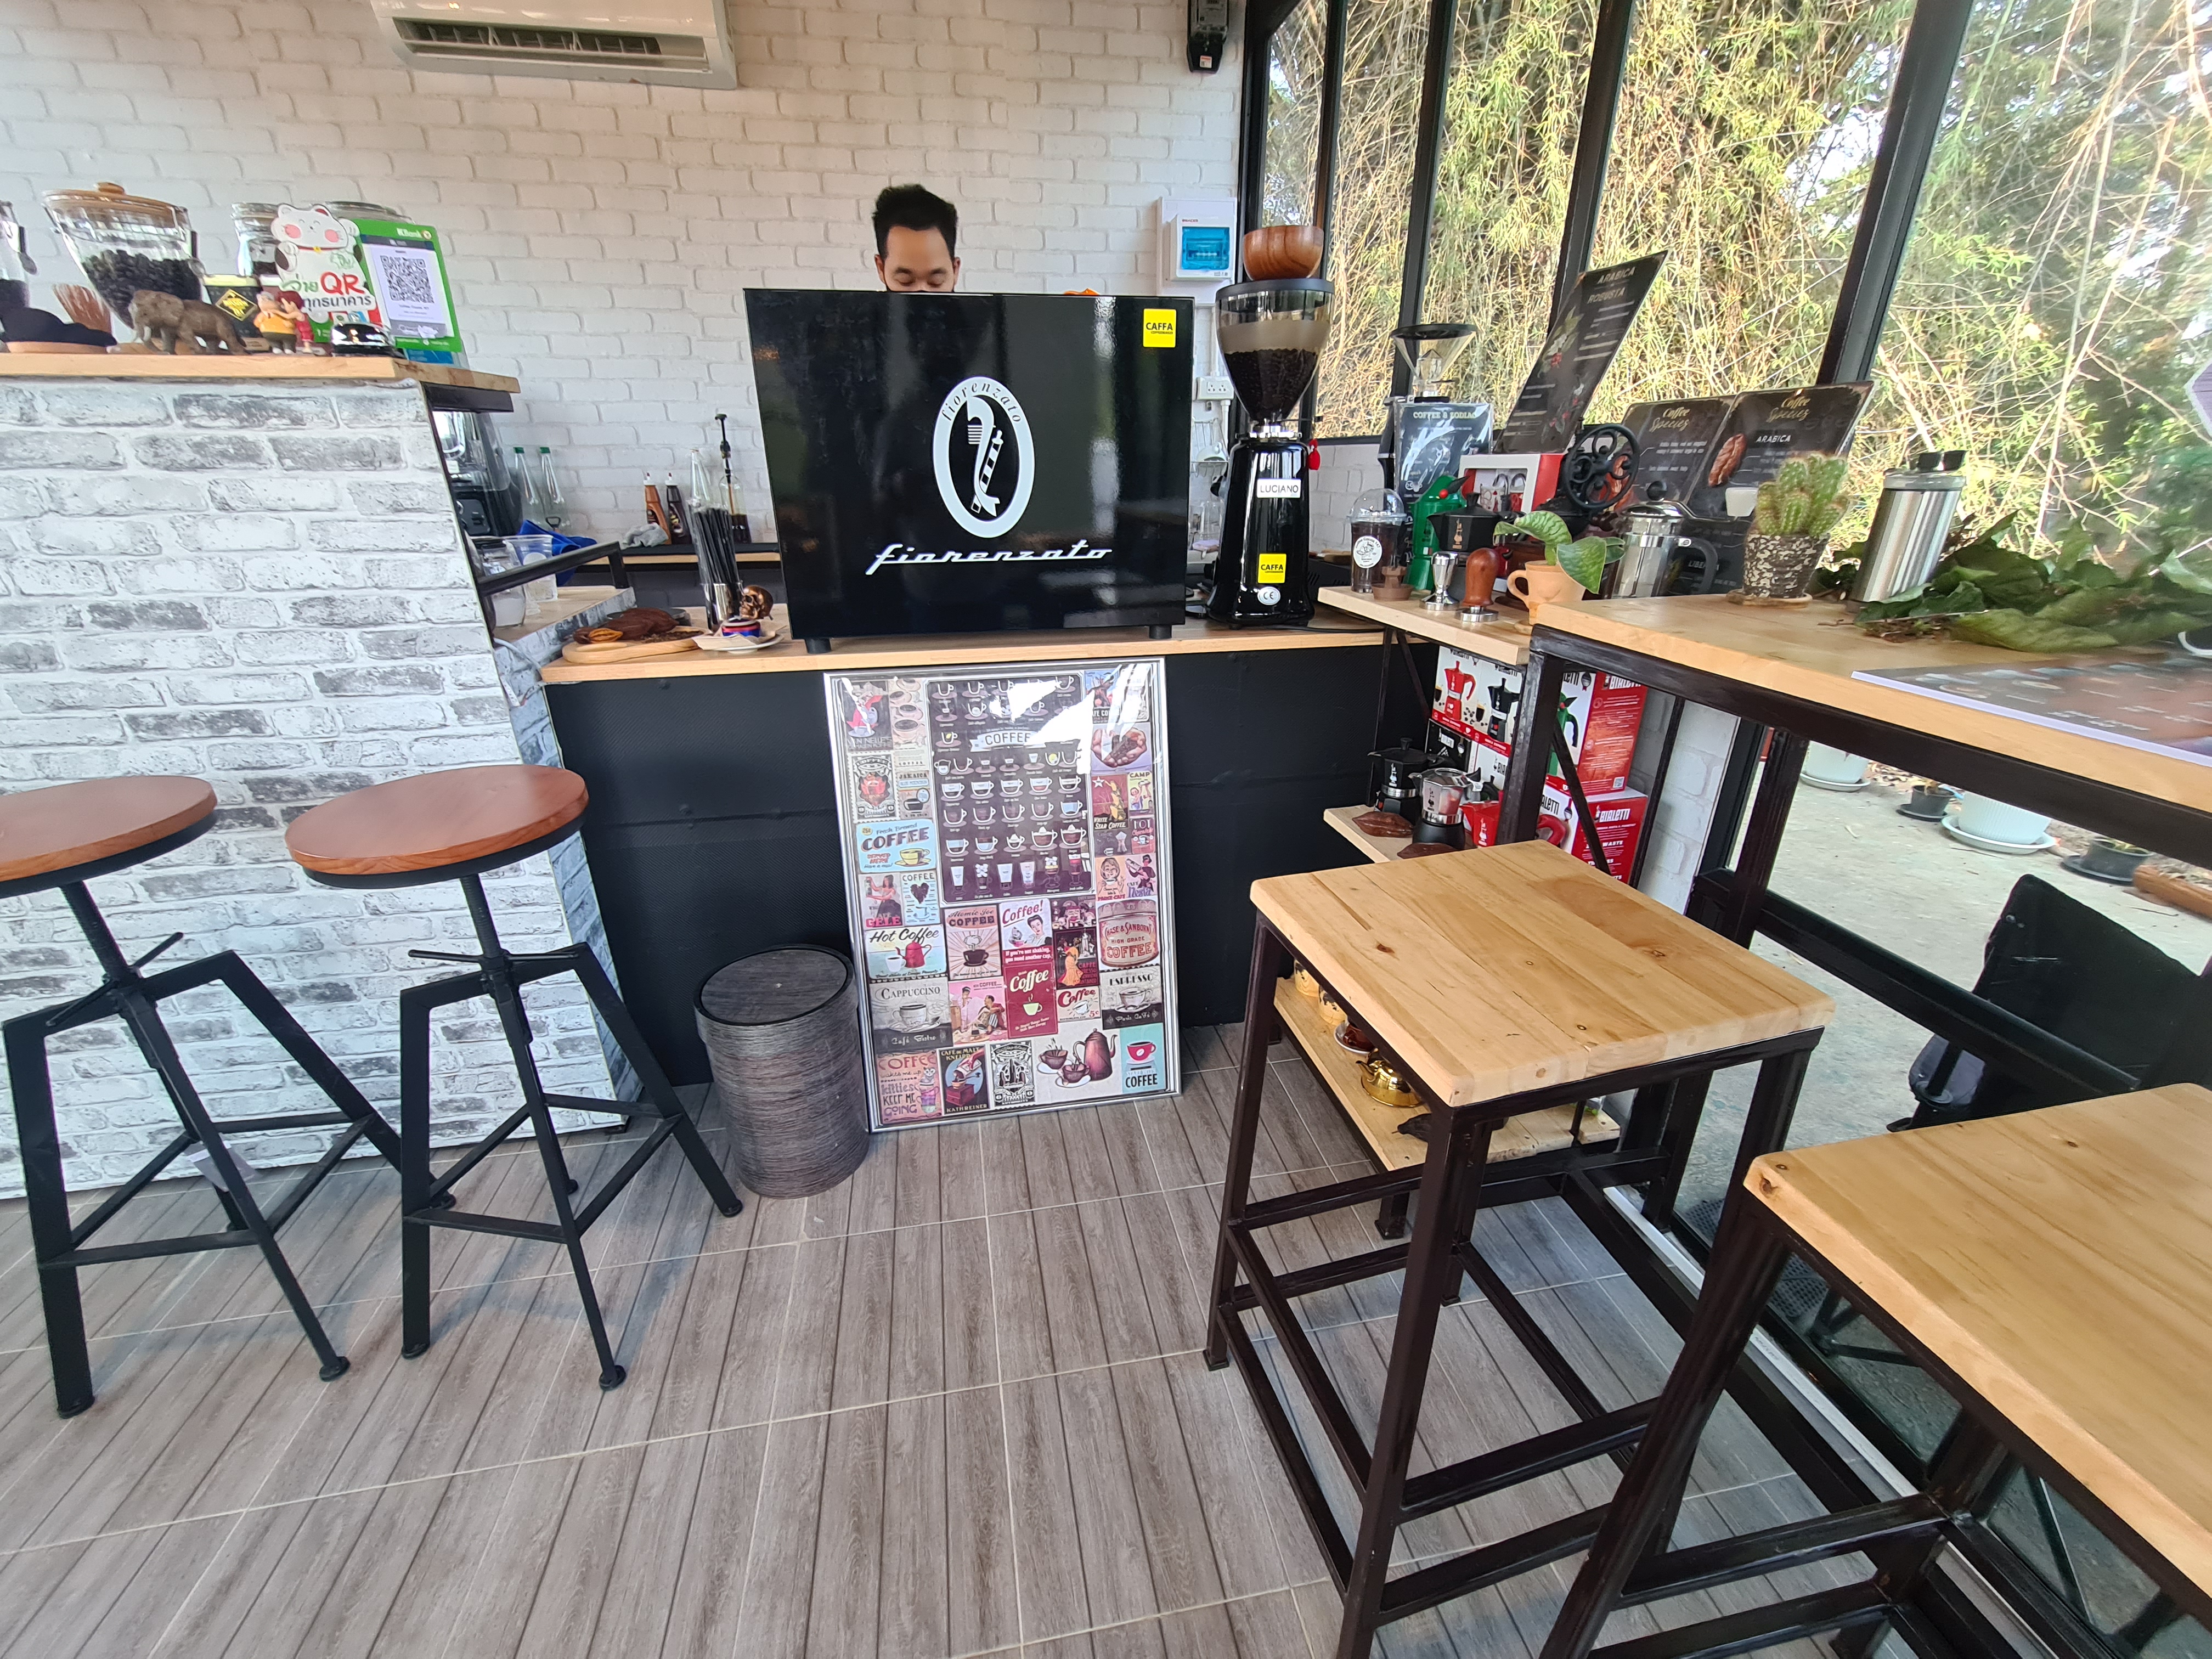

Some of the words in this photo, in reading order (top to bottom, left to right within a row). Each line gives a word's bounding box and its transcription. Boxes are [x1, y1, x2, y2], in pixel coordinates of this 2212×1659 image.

[1597, 267, 1635, 284] ARABICA
[320, 271, 365, 296] QR
[1146, 322, 1173, 331] CAFFA
[941, 383, 1022, 422] fiorenzato
[1781, 396, 1810, 409] Coffee
[1663, 407, 1690, 419] Coffee
[1756, 435, 1791, 443] ARABICA
[1260, 485, 1299, 493] LUCIANO
[865, 539, 1113, 575] fiorenzato
[1263, 591, 1274, 600] CE
[1600, 808, 1630, 822] BIALETTI
[895, 823, 917, 831] Brewed
[861, 827, 929, 851] COFFEE
[902, 873, 934, 882] COFFEE
[948, 910, 978, 918] Atomic
[980, 908, 994, 916] Joe
[1002, 900, 1043, 924] Coffee!
[949, 916, 995, 927] COFFEE
[870, 930, 895, 943] Hot
[899, 927, 939, 945] Coffee
[1107, 942, 1152, 958] COFFEE
[1009, 969, 1049, 992] Coffee
[1110, 973, 1153, 986] ESPRESSO
[881, 986, 940, 1000] CAPPUCCINO
[1058, 988, 1096, 1007] Coffee
[891, 1036, 910, 1046] Café
[878, 1053, 936, 1070] COFFEE
[1126, 1074, 1158, 1088] COFFEE
[881, 1082, 913, 1096] kitties
[883, 1094, 904, 1106] KEEP
[906, 1093, 915, 1104] ME
[884, 1104, 917, 1117] GOING
[946, 1104, 988, 1113] KATHREINER
